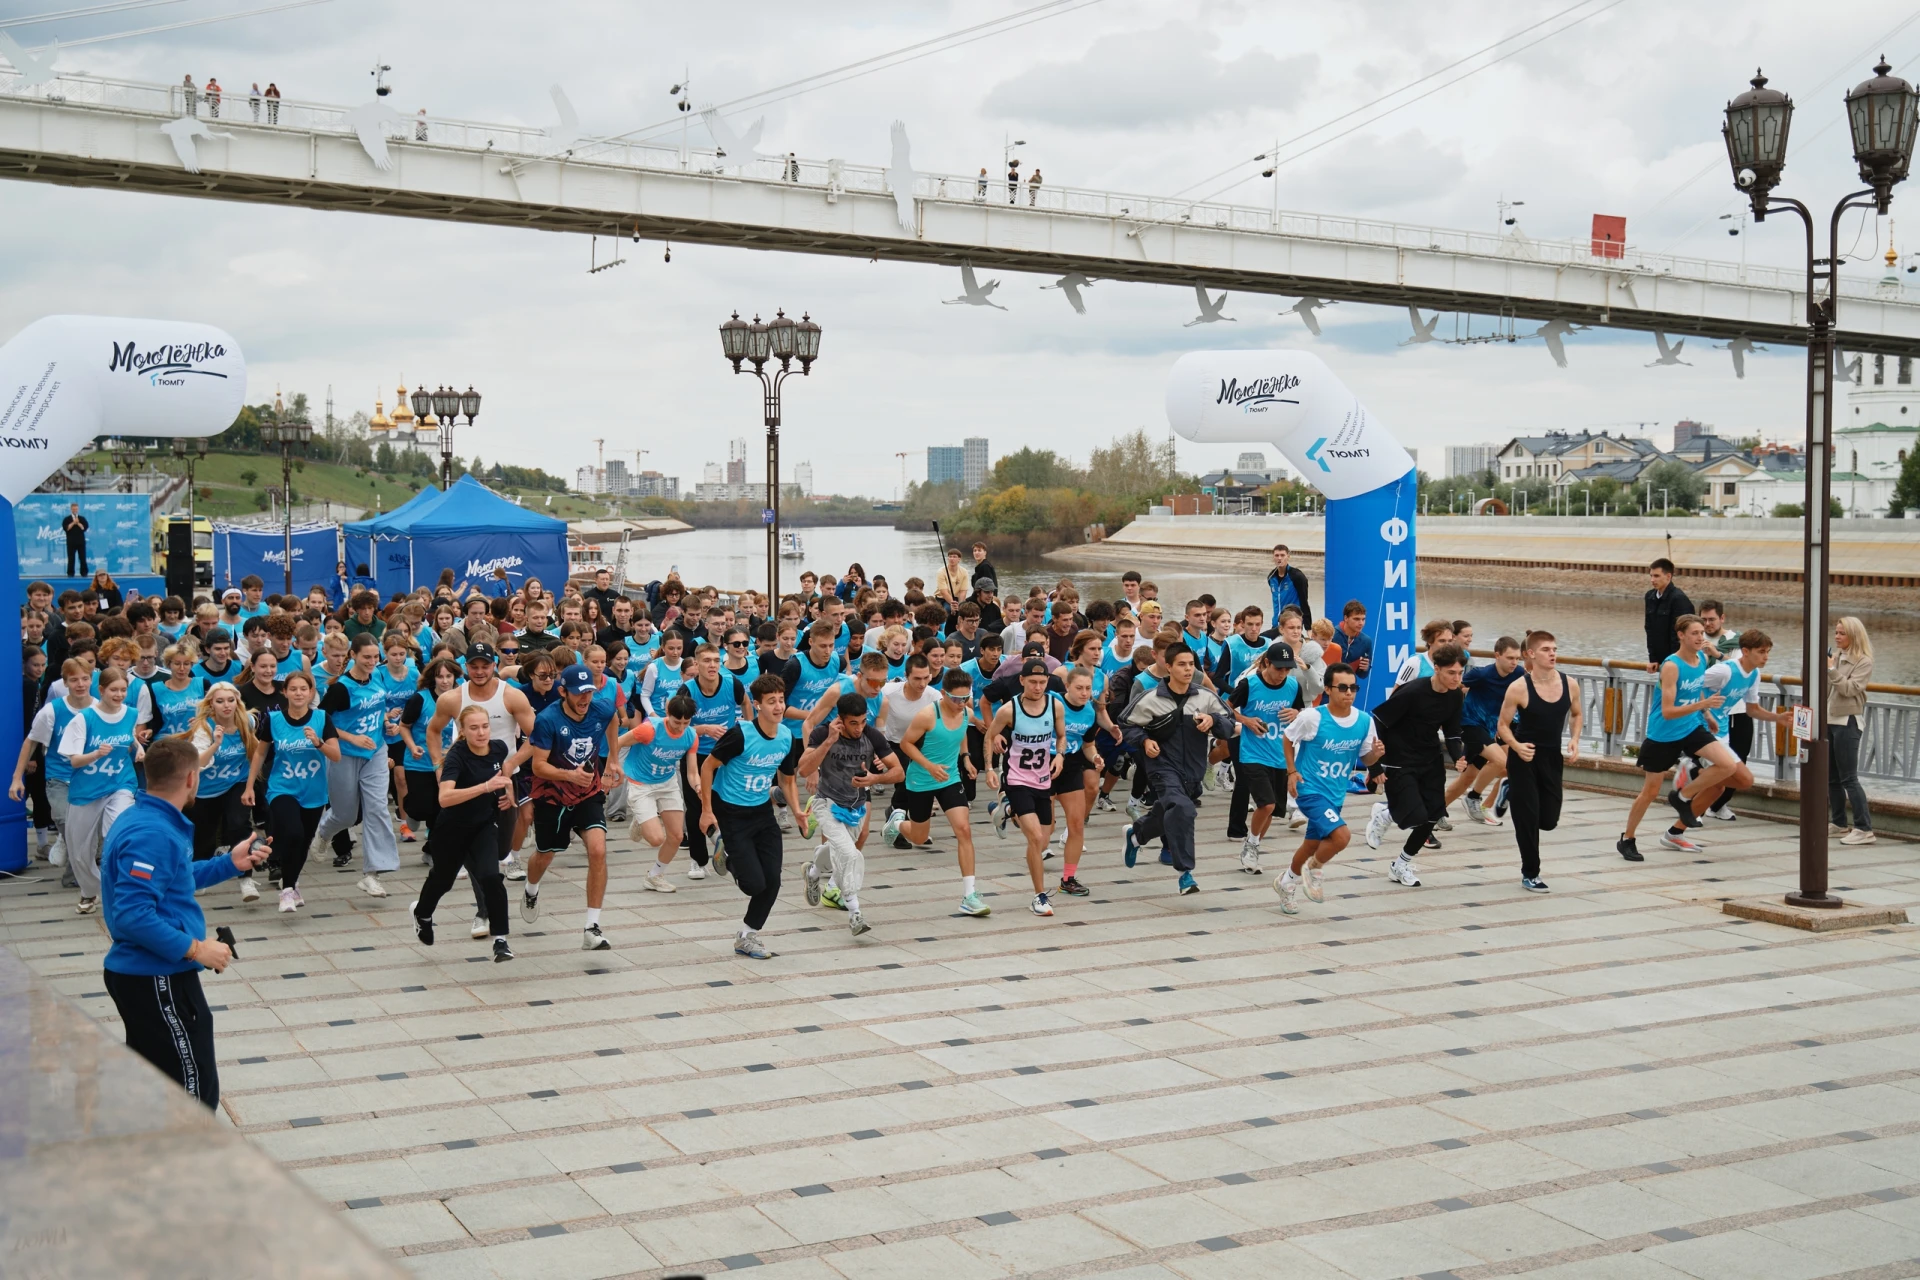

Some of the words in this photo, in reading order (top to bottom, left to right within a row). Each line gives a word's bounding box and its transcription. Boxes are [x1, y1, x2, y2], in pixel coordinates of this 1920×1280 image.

[1380, 517, 1409, 700] ФИНИ
[831, 752, 867, 762] MANTO
[1019, 748, 1046, 770] 23
[282, 759, 321, 779] 349
[1324, 808, 1340, 823] 9
